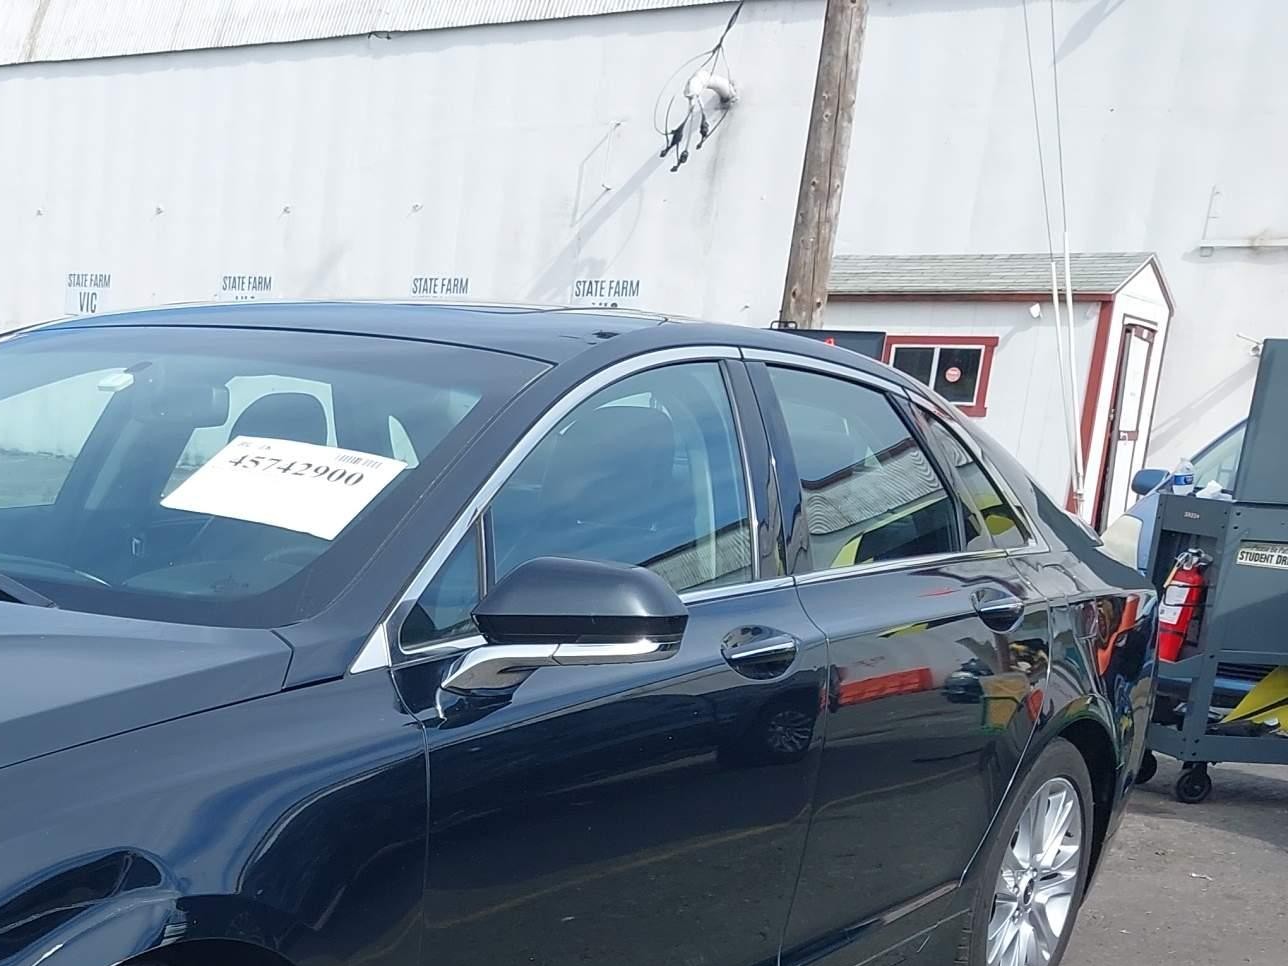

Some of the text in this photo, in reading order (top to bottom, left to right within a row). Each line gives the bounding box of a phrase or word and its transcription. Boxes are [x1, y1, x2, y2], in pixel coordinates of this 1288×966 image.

[67, 273, 111, 288] STATE FARM
[222, 275, 272, 291] STATE FARM
[412, 277, 469, 294] STATE FARM
[575, 279, 640, 297] STATE FARM
[79, 291, 97, 314] VIC
[228, 454, 365, 487] 45742900
[1239, 550, 1288, 566] STUDENT DR
